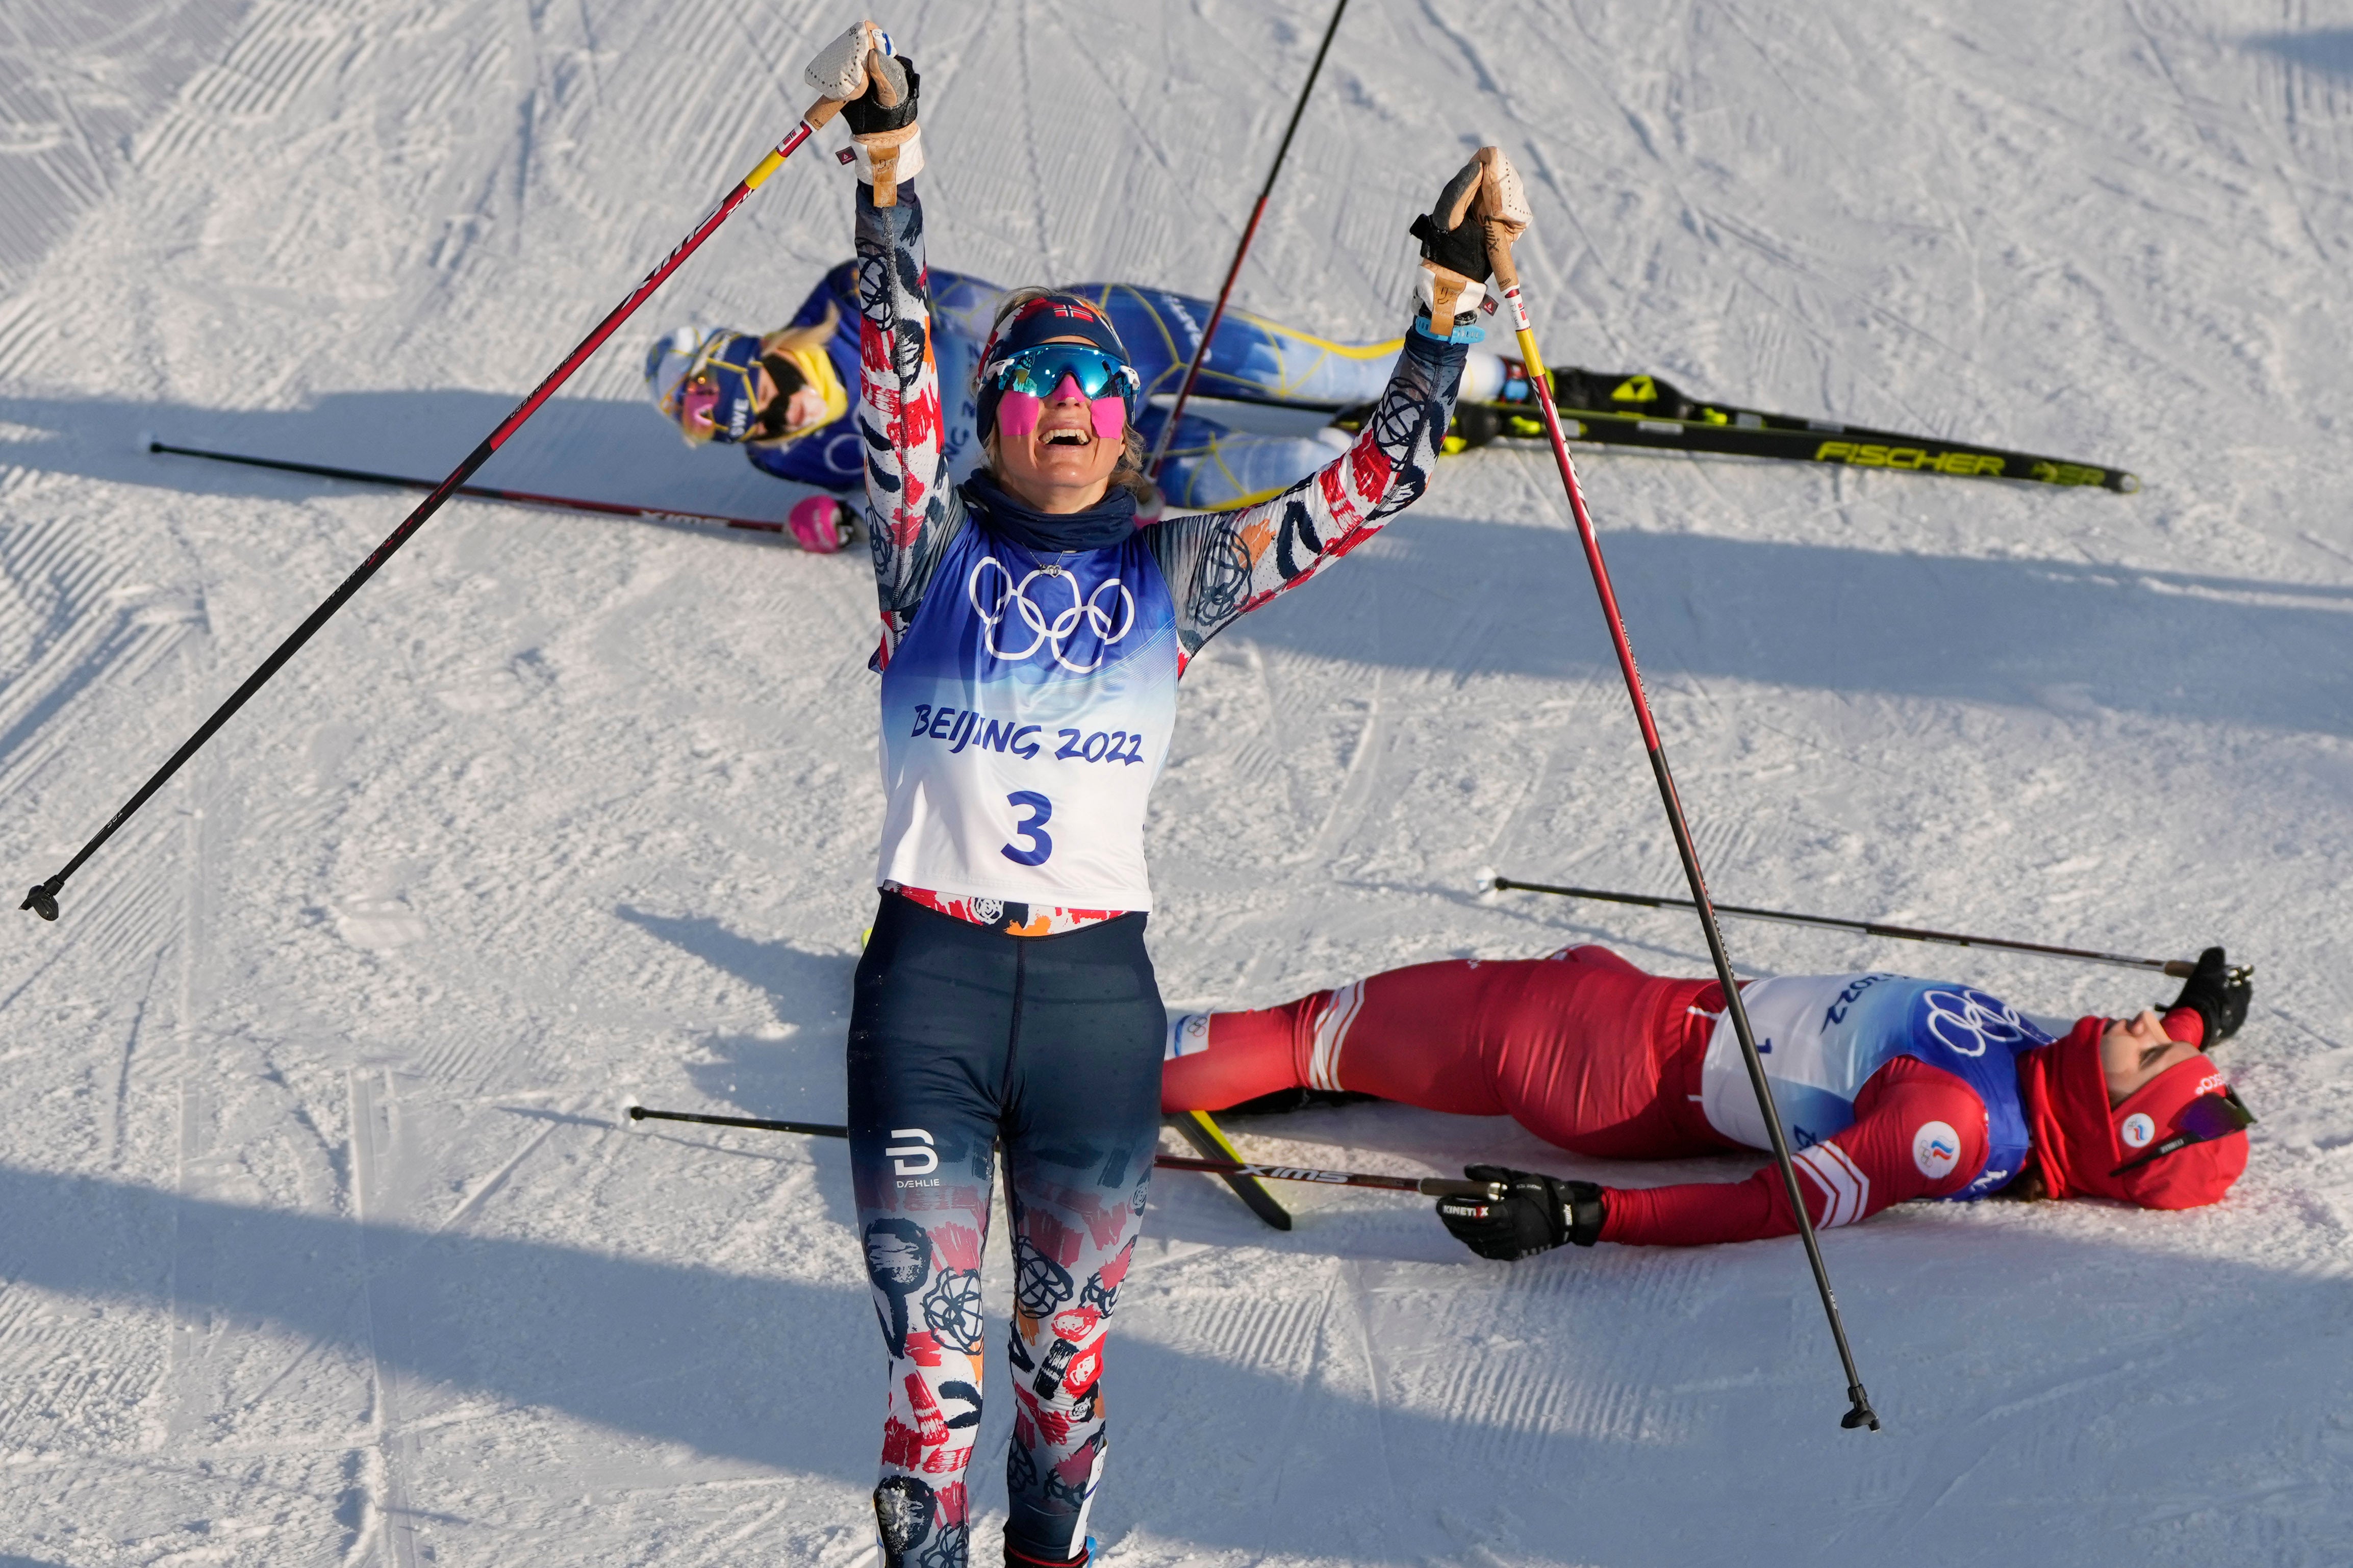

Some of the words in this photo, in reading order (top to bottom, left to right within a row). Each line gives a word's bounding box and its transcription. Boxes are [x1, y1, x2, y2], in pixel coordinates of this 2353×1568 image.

[729, 398, 749, 436] SWE
[1815, 441, 2006, 477] FISCHER
[911, 703, 1042, 759] BEIJING
[1054, 728, 1144, 766] 2022
[1001, 790, 1053, 866] 3
[896, 1178, 940, 1188] DÆHLIE
